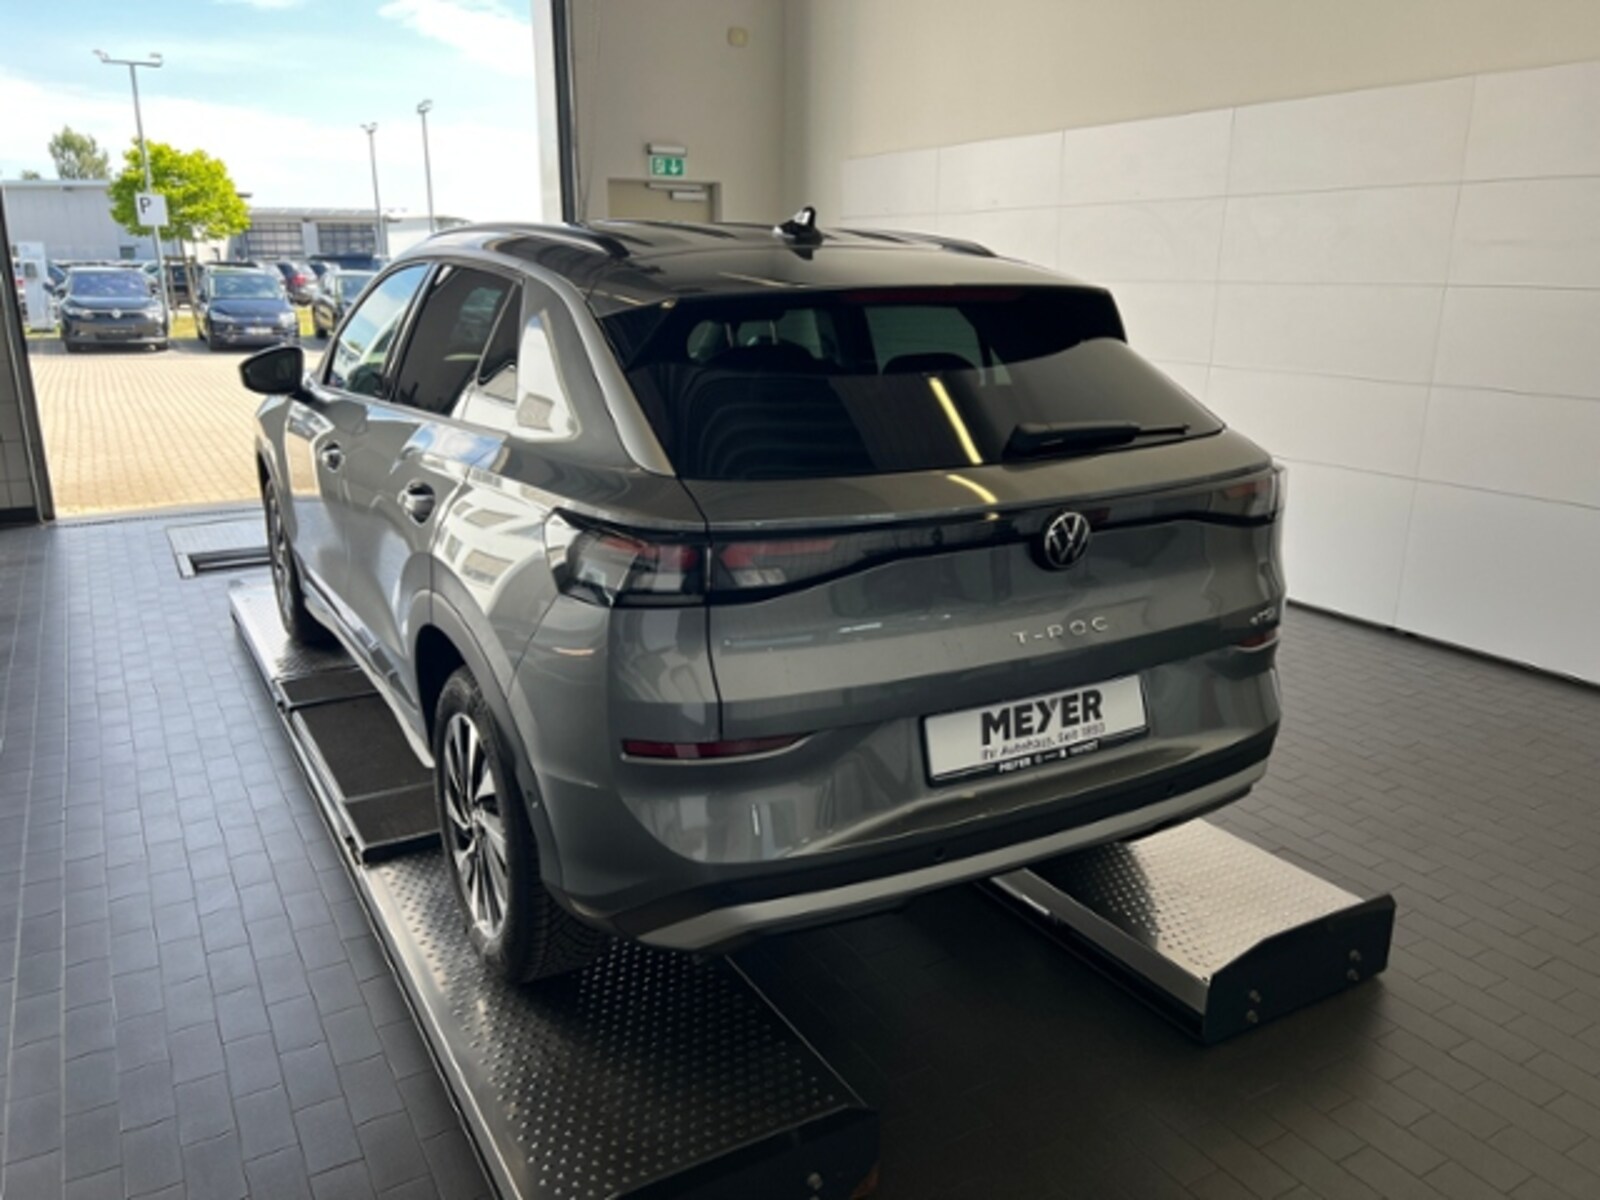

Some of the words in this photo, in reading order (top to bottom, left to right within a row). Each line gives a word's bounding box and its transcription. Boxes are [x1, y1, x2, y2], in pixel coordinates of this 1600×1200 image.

[139, 197, 152, 215] P
[1010, 616, 1109, 644] T-ROC
[981, 689, 1103, 746] MEYER
